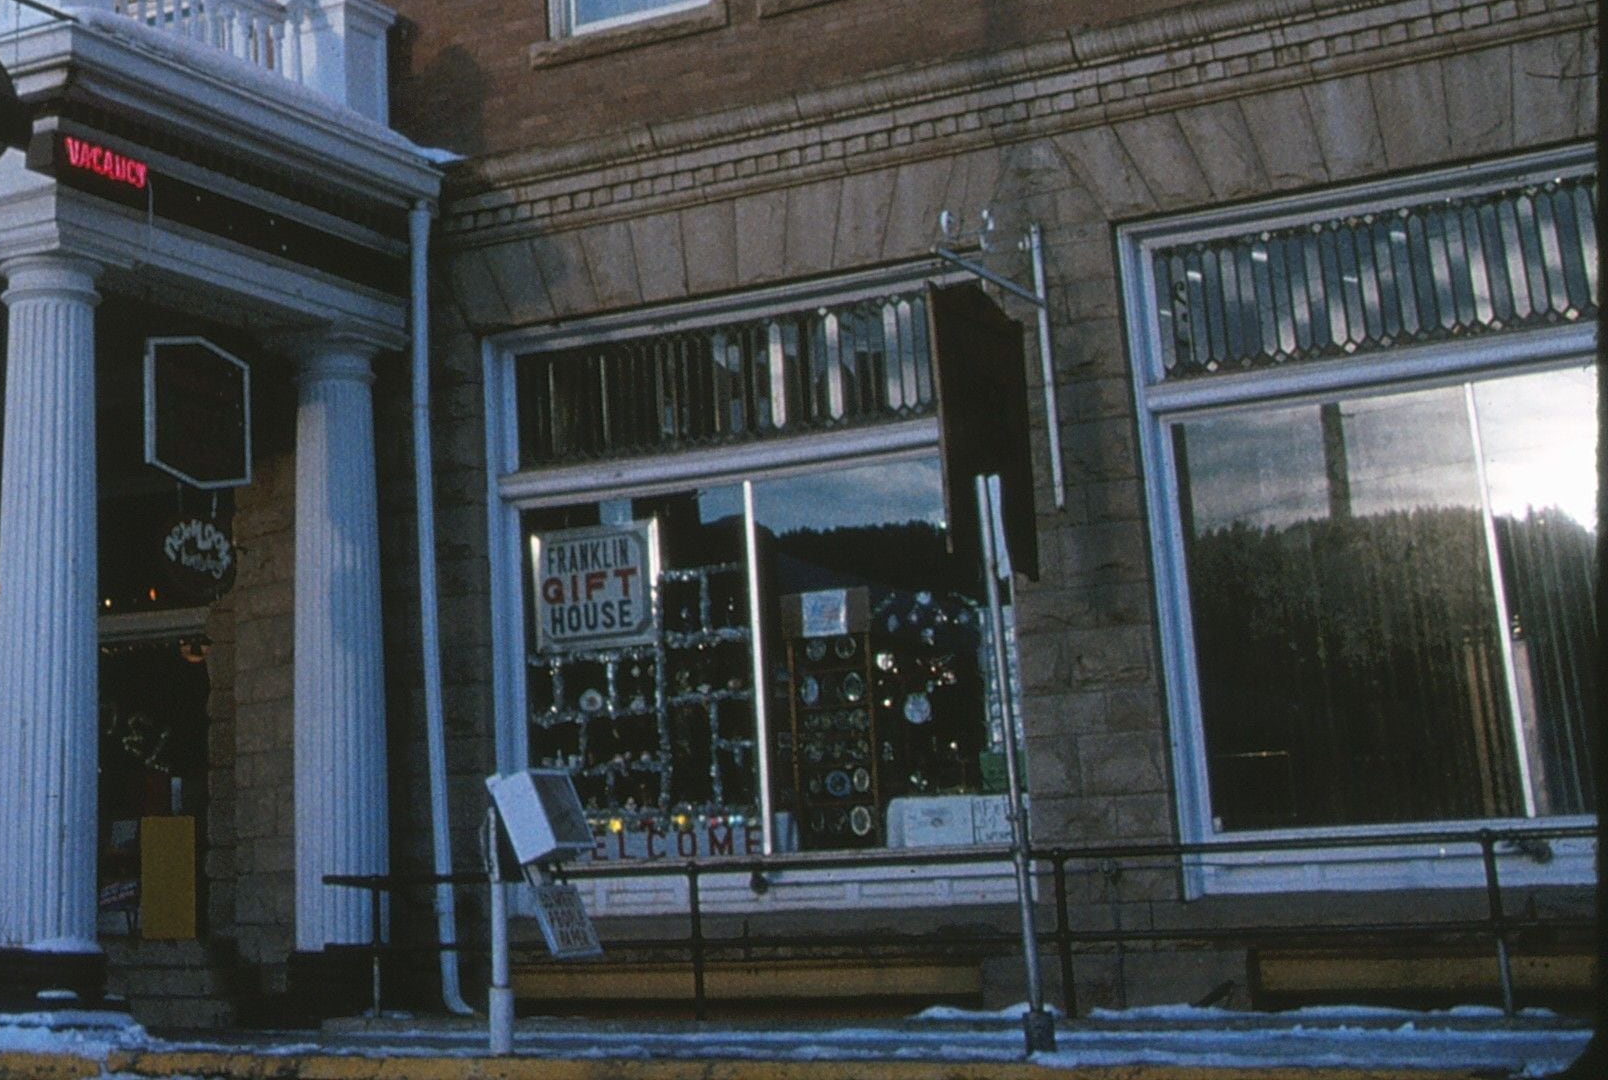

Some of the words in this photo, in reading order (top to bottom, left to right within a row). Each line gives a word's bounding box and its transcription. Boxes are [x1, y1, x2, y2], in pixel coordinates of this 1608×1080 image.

[64, 136, 147, 188] VACANCY
[547, 537, 630, 574] FRANKLIN
[542, 567, 638, 605] GIFT
[551, 599, 633, 635] HOUSE
[588, 824, 763, 860] ELCOME
